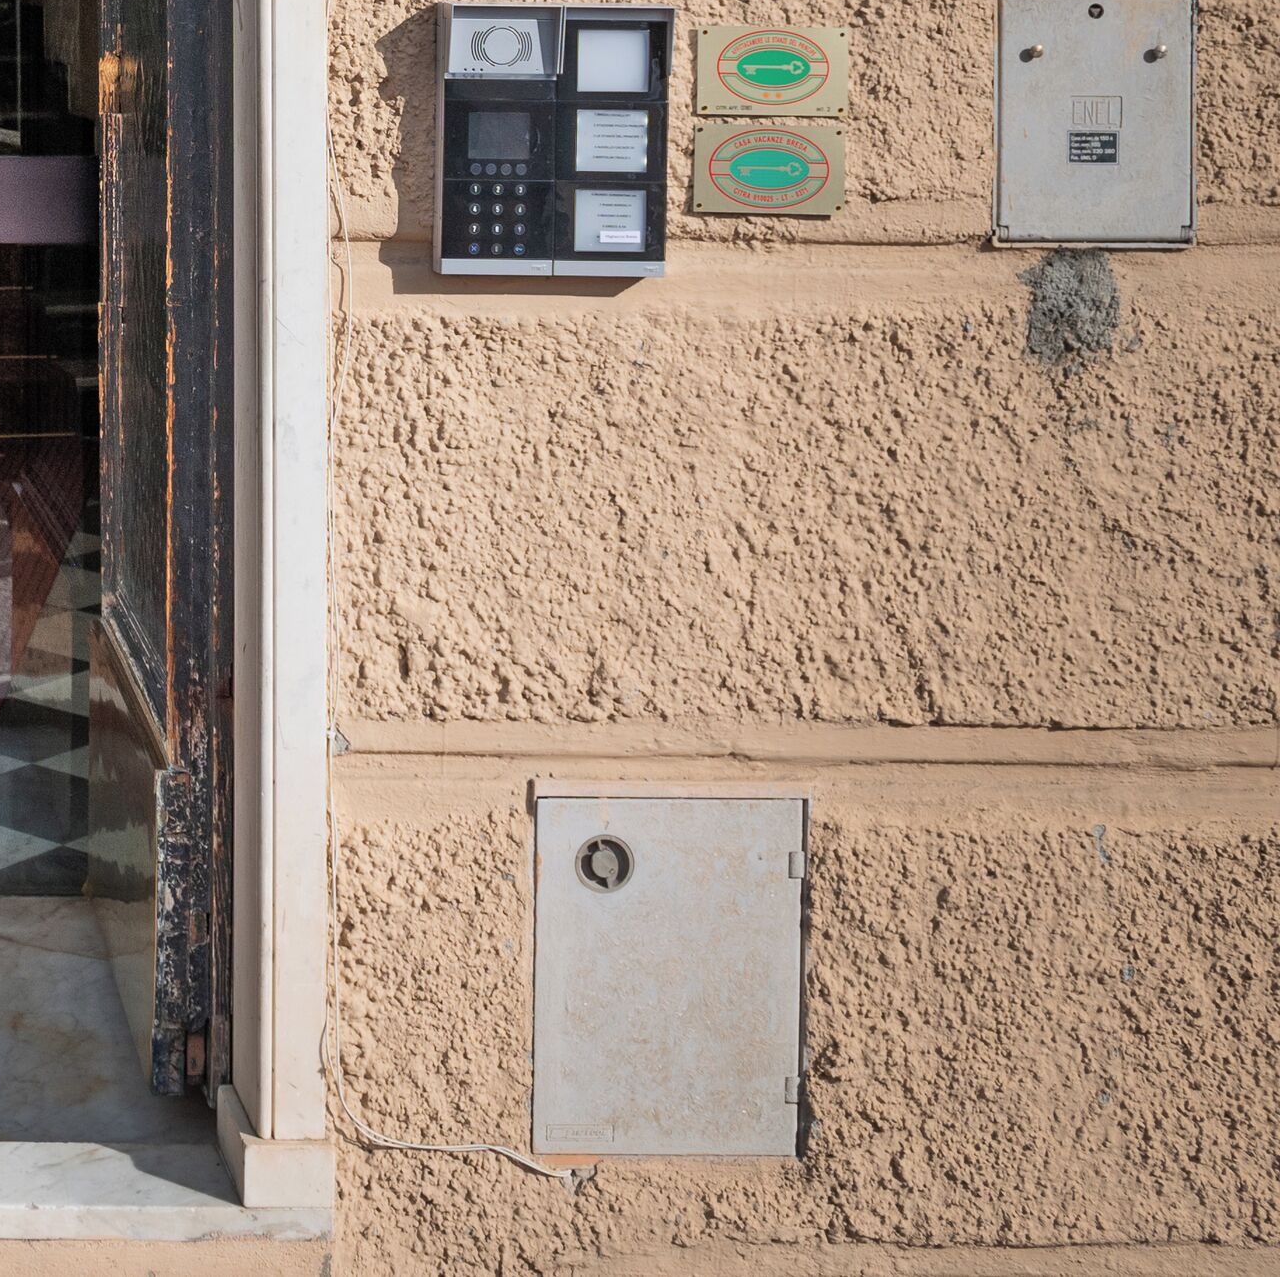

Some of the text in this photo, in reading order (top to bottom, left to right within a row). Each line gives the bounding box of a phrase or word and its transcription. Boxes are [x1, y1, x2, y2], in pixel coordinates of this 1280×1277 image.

[1072, 99, 1117, 125] ENEL
[734, 138, 751, 149] CASA
[786, 138, 809, 153] BREDA
[733, 187, 751, 199] CITRA
[780, 193, 788, 201] LT
